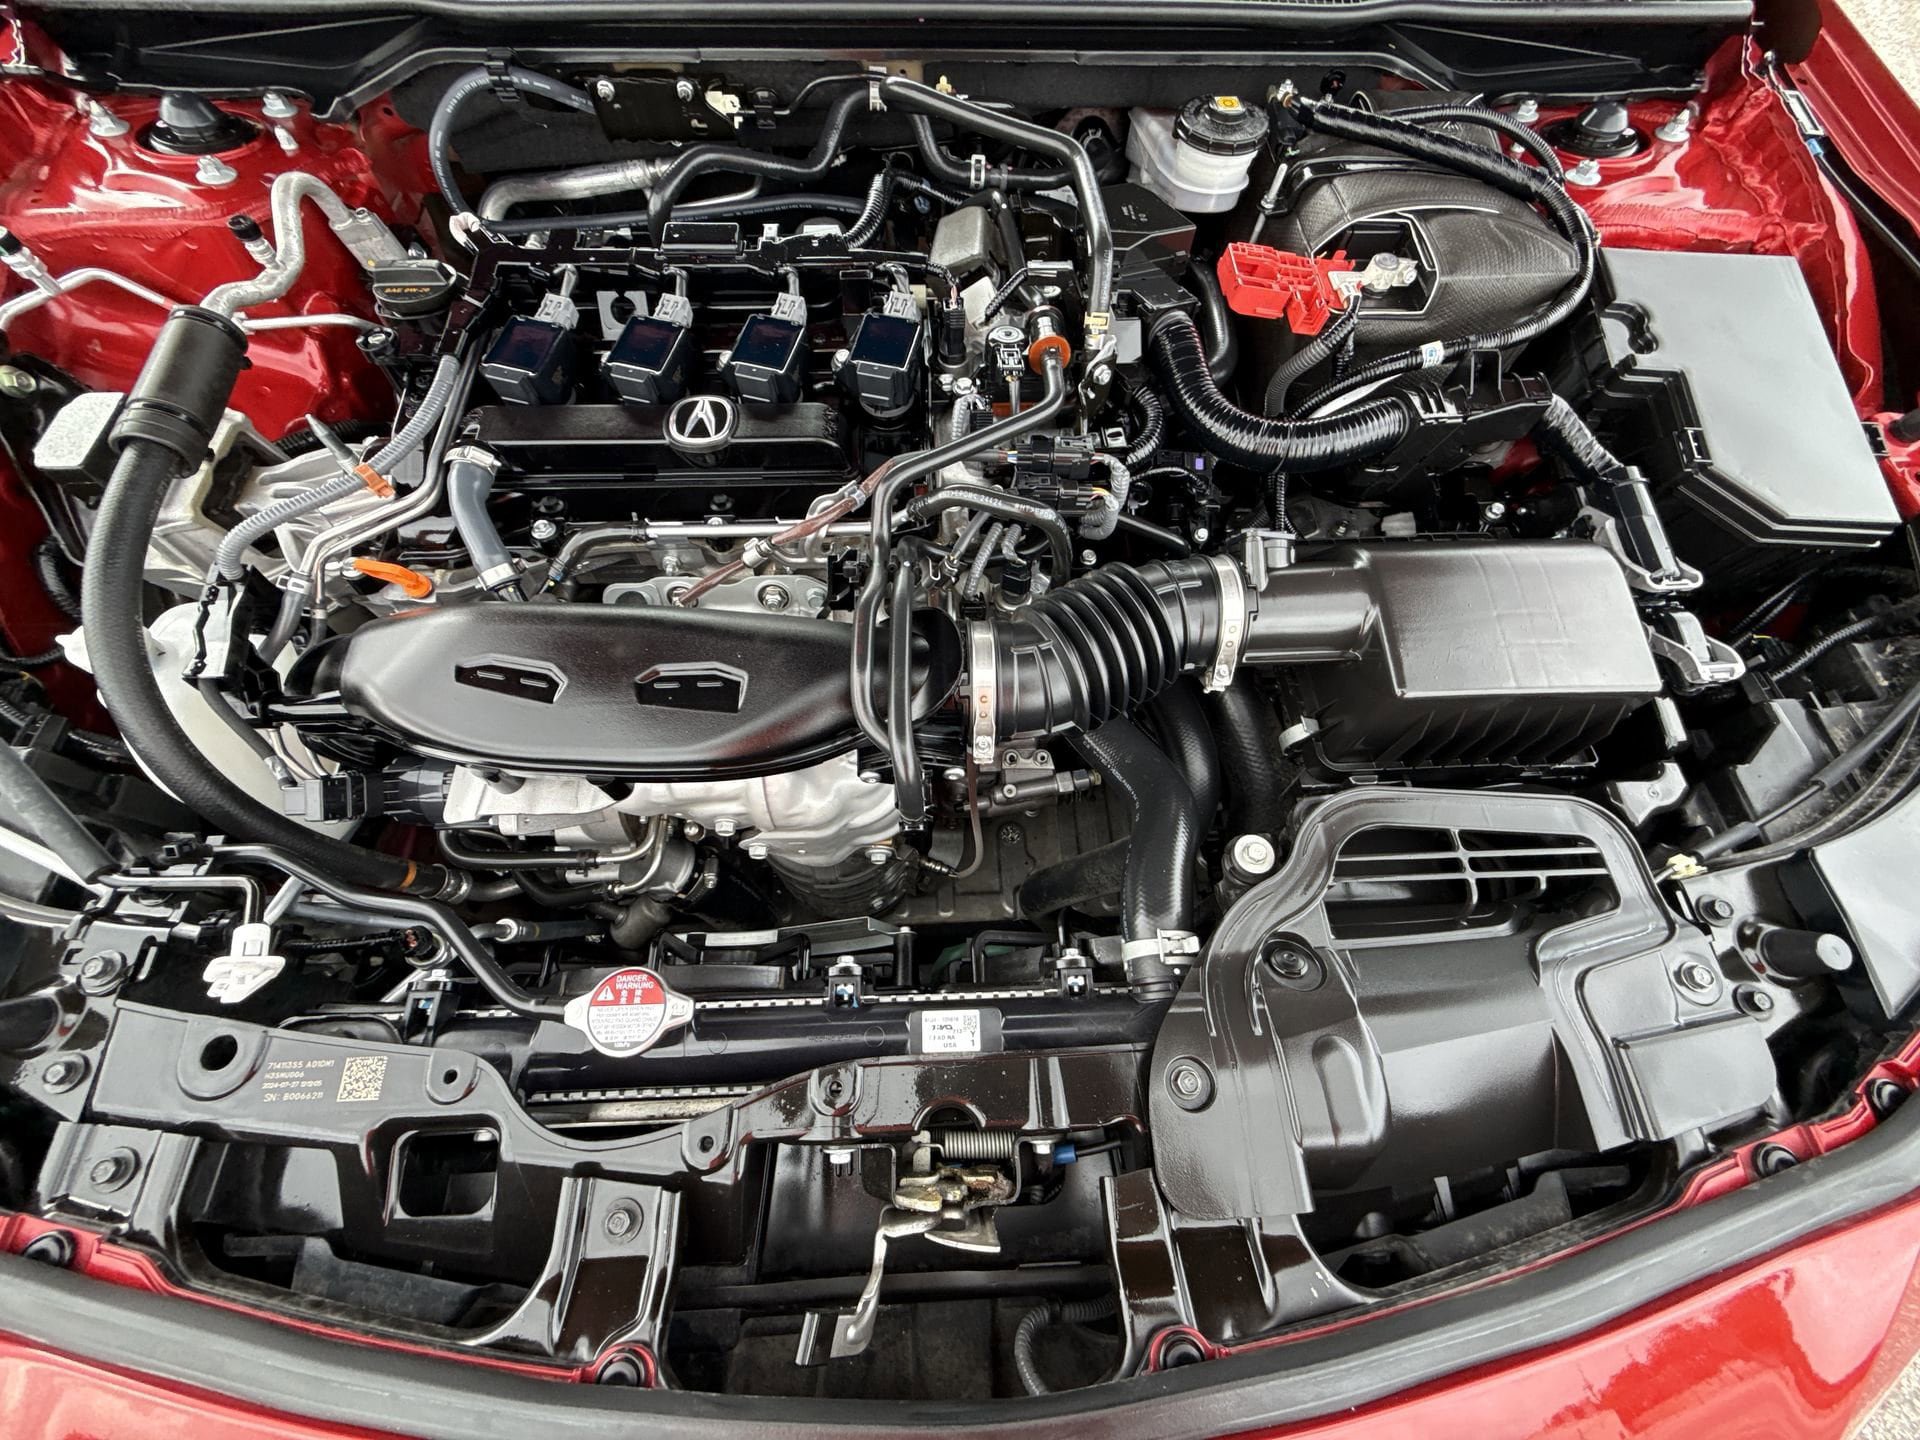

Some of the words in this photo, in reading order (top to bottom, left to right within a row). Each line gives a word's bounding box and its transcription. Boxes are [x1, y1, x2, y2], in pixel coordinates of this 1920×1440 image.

[616, 974, 648, 982] DANGER
[616, 981, 654, 990] WARNUNG
[970, 1030, 976, 1038] Y
